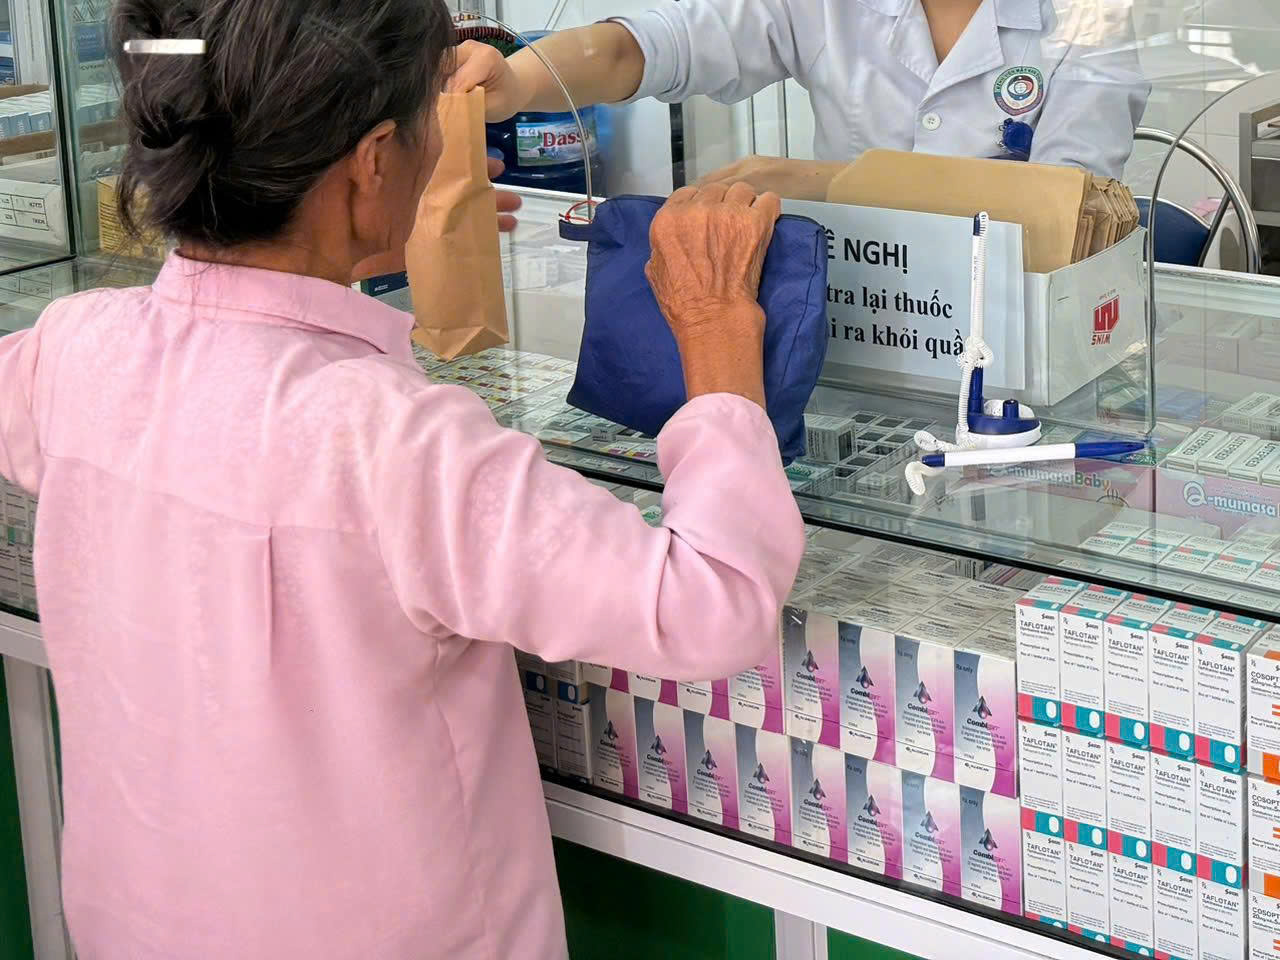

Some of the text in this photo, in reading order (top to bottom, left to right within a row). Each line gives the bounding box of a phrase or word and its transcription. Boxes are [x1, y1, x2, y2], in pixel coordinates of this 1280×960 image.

[844, 238, 908, 274] NGHỊ
[862, 287, 887, 315] lại
[894, 289, 952, 319] thuốc
[844, 325, 865, 342] ra
[872, 324, 918, 350] khỏi
[925, 329, 964, 359] quầ
[1074, 471, 1112, 491] Baby
[1020, 620, 1056, 632] TAFLOTAN
[1064, 628, 1099, 641] TAFLOTAN
[1108, 639, 1144, 652] TAFLOTAN
[1152, 648, 1190, 661] TAFLOTAN
[1198, 659, 1235, 673] TAFLOTAN
[1022, 736, 1057, 749] TAFLOTAN
[1066, 747, 1101, 761] TAFLOTAN
[1109, 758, 1146, 772] TAFLOTAN
[1154, 769, 1191, 784] TAFLOTAN
[1200, 782, 1237, 796] TAFLOTAN
[1202, 893, 1239, 908] TAFLOTAN
